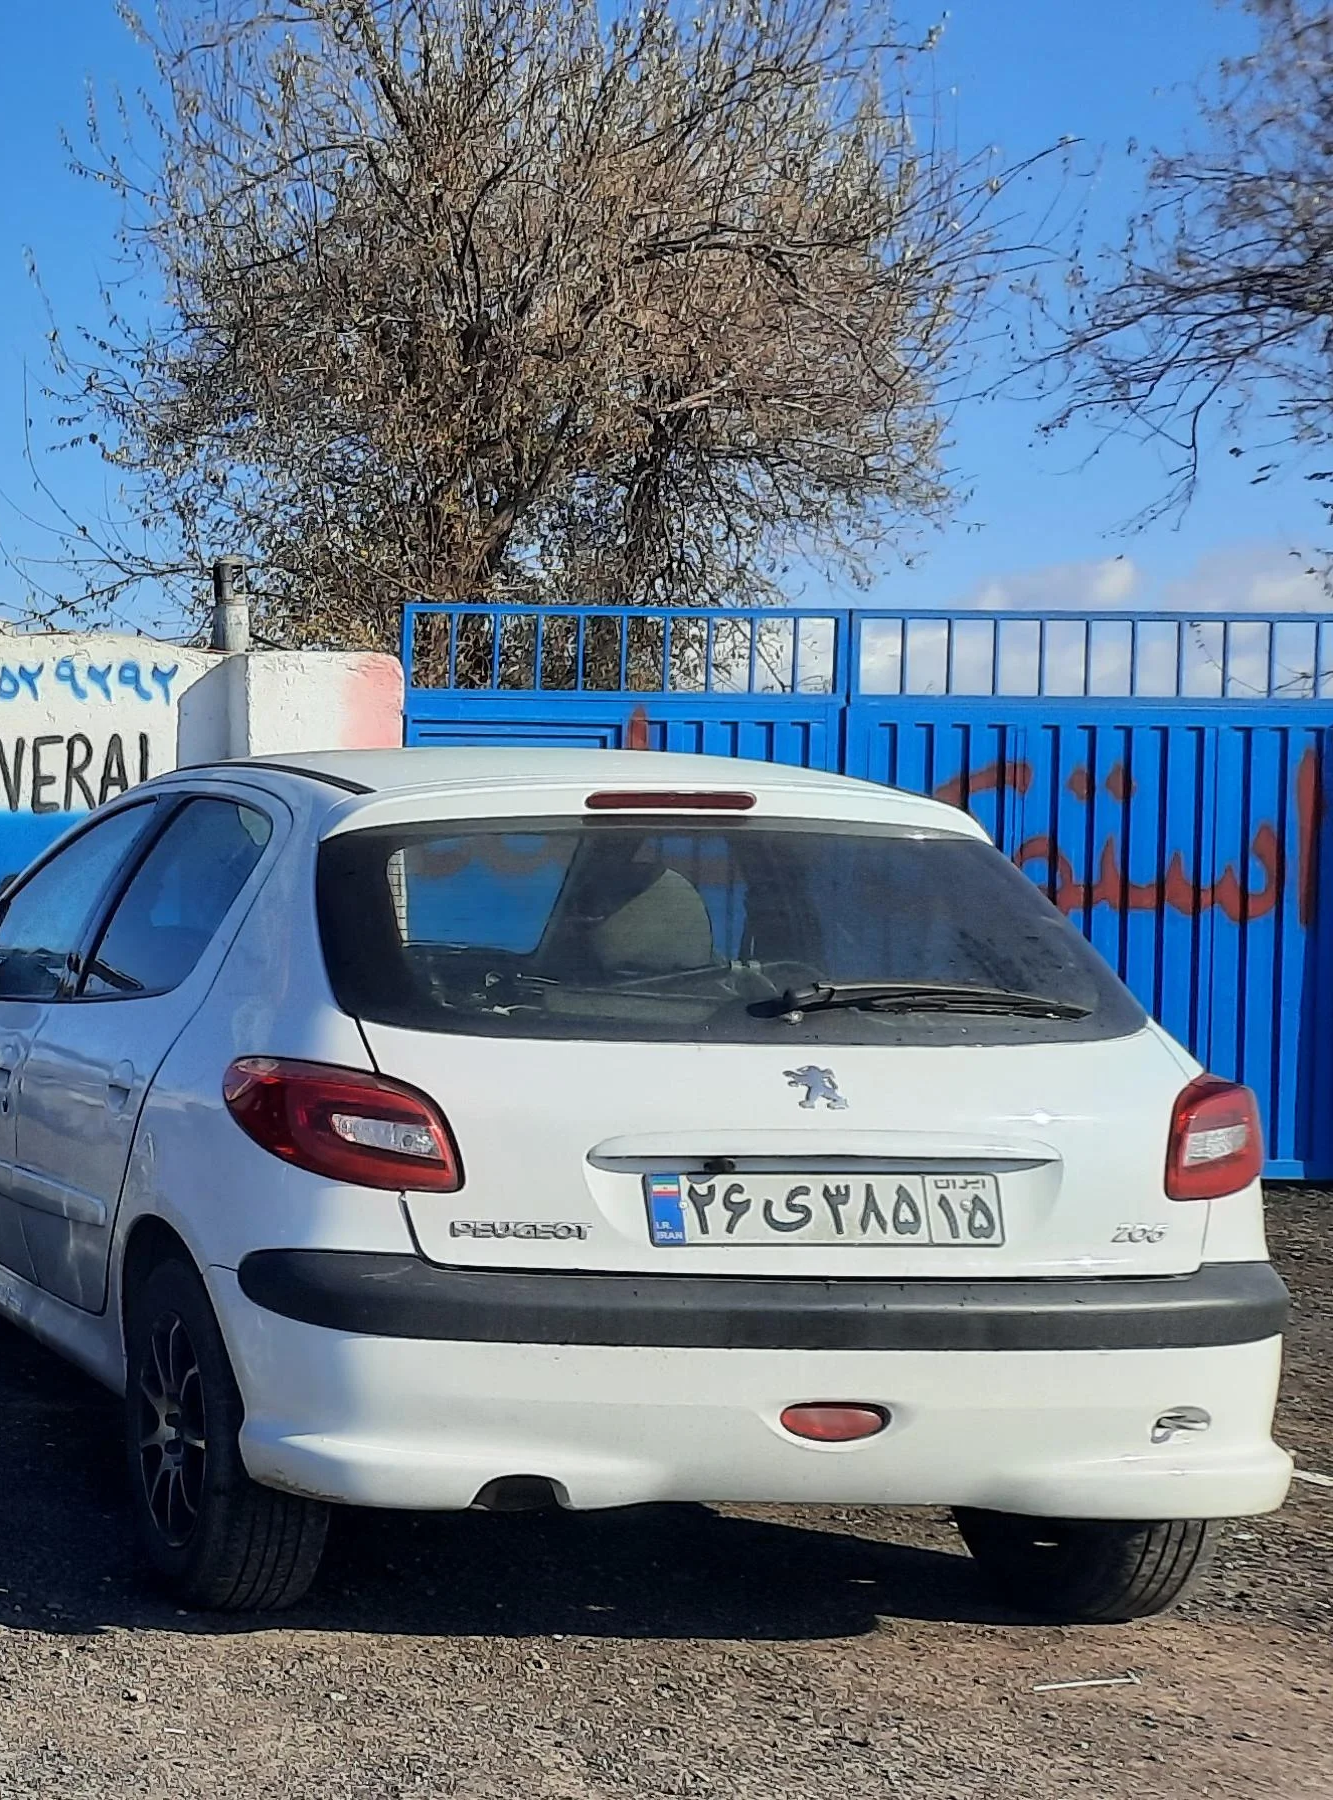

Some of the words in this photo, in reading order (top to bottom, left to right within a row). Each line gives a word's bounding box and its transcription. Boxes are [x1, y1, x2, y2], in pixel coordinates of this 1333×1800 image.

[938, 1193, 996, 1239] ۱۵
[449, 1221, 593, 1241] PEUGEOT
[656, 1232, 683, 1241] IRAN
